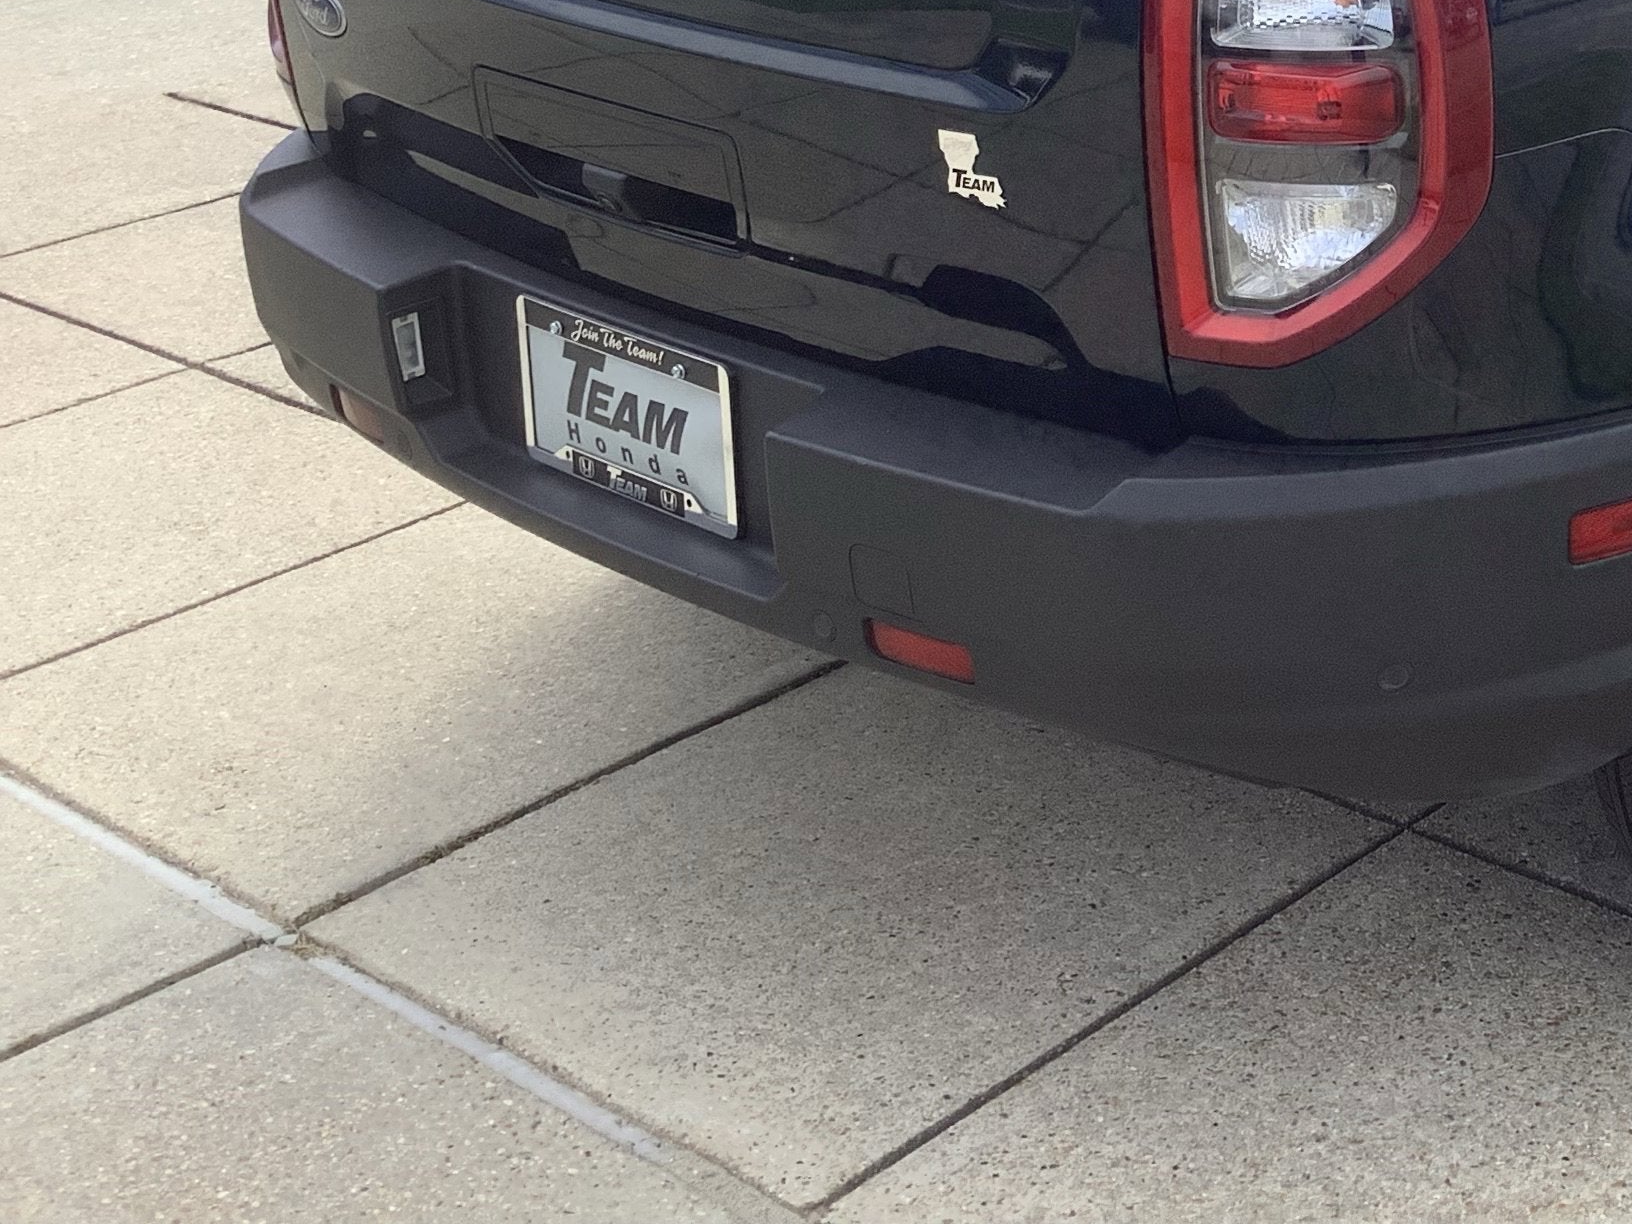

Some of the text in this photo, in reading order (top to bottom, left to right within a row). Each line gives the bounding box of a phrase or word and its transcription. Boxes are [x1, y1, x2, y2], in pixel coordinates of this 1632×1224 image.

[571, 319, 664, 365] Join The Team!
[567, 420, 688, 486] Honda
